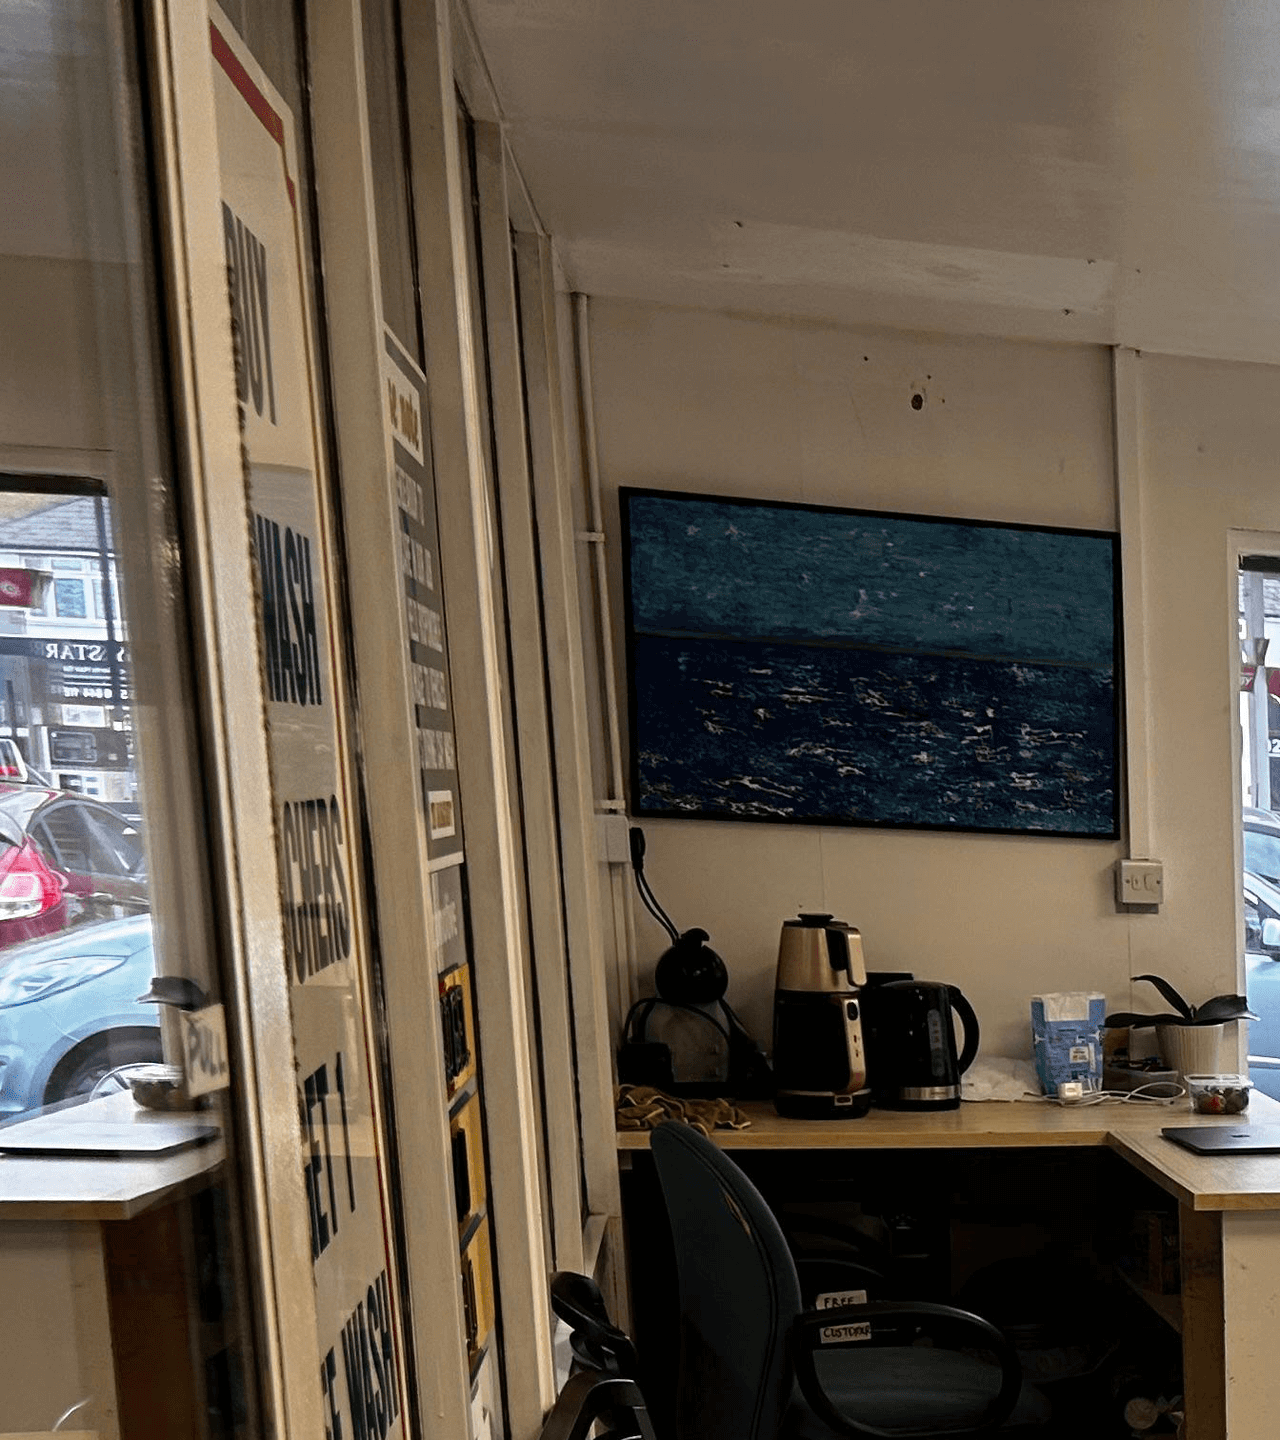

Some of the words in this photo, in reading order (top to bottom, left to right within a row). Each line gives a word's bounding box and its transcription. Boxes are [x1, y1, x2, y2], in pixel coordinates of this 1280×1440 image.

[254, 512, 323, 708] WASH
[281, 793, 350, 985] CHERS
[335, 1050, 356, 1213] 1
